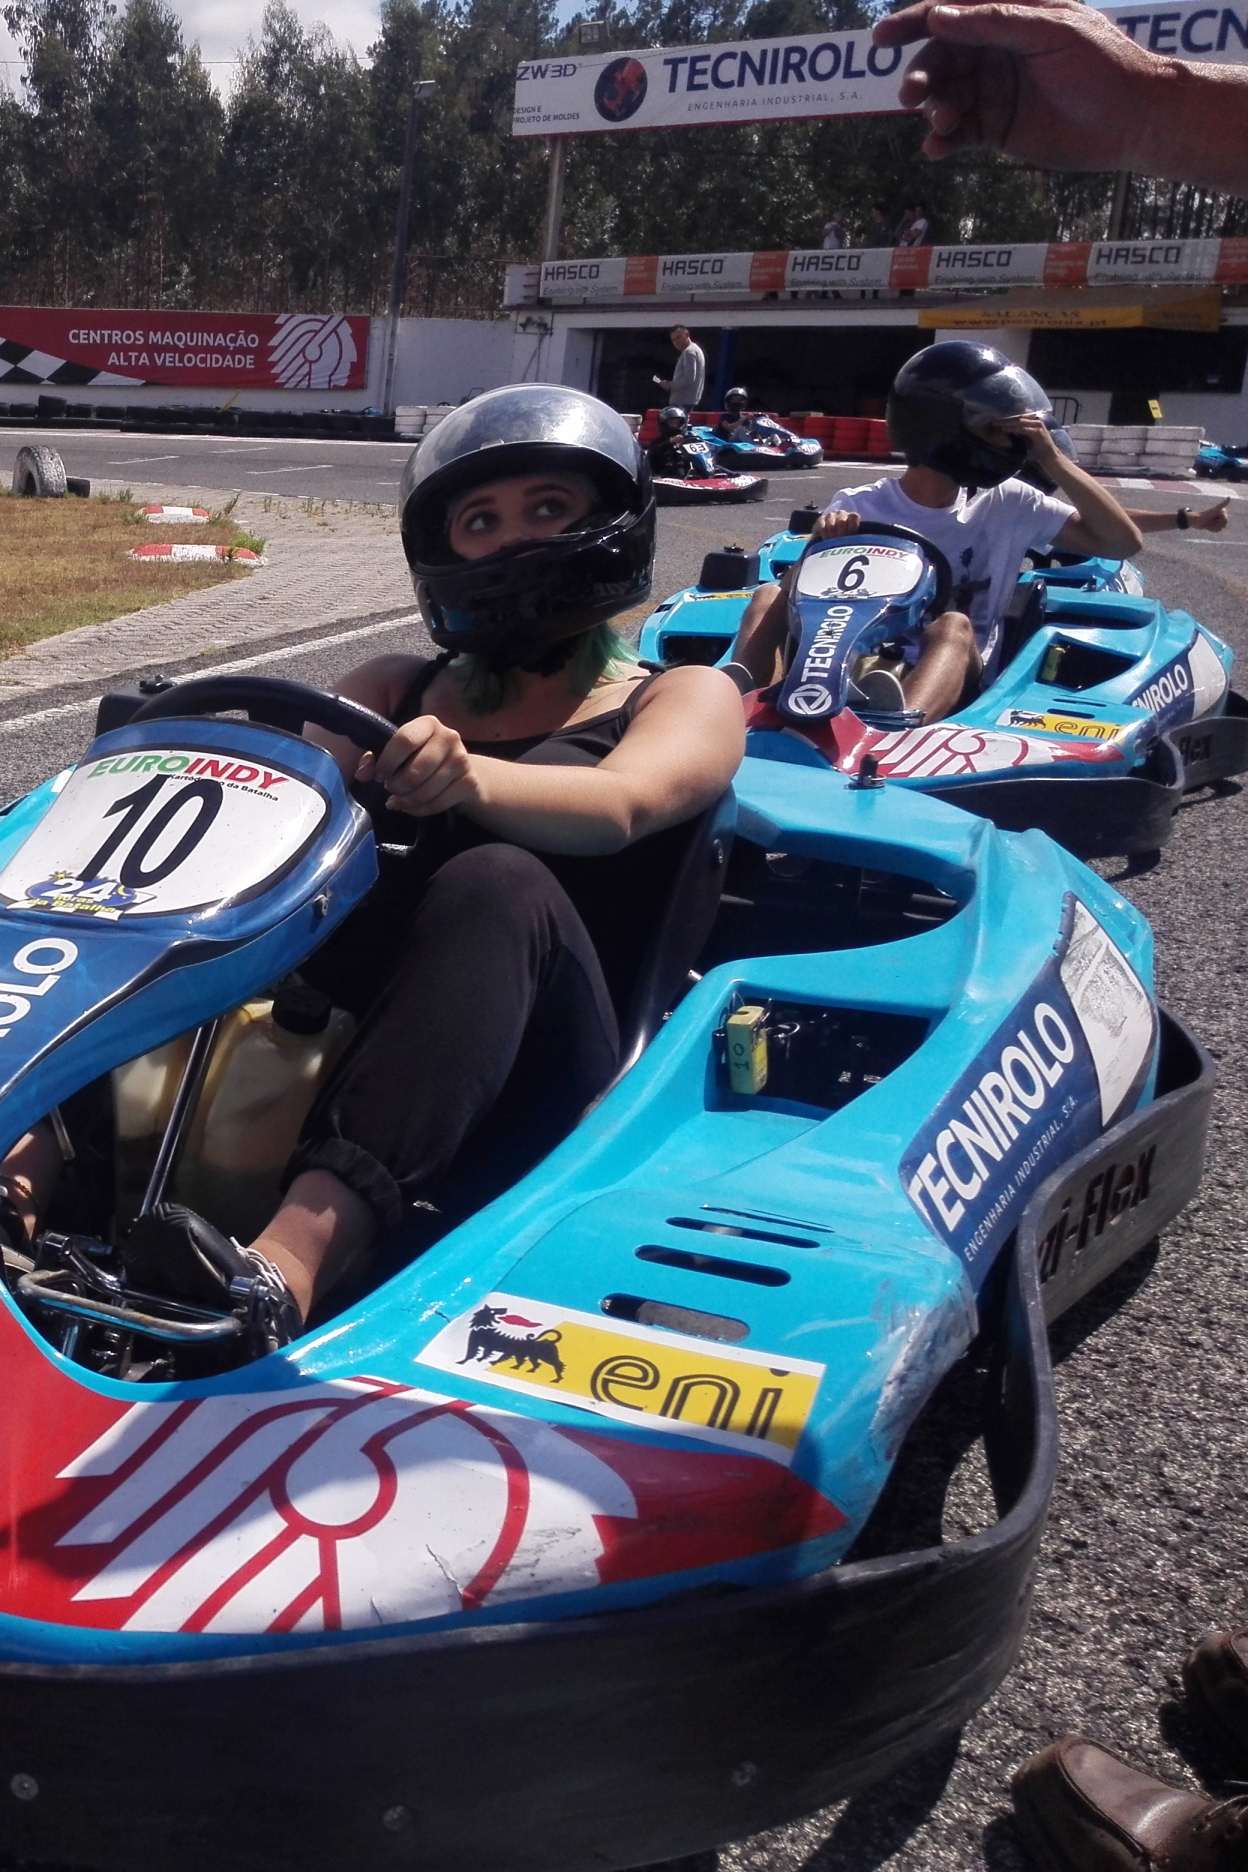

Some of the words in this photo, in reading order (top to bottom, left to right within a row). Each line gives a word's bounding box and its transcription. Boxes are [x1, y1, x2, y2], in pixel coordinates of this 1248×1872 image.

[516, 63, 577, 80] ZW3D
[663, 41, 902, 93] TECNIROLO
[687, 99, 758, 112] ENGENHARIA
[791, 254, 861, 272] HASCO
[936, 250, 1012, 268] HASCO
[1095, 246, 1181, 265] HASCO
[544, 264, 600, 281] HASCO
[662, 259, 724, 276] HASCO
[68, 329, 144, 345] CENTROS
[148, 329, 259, 350] MAQUINAÇÃO
[108, 351, 150, 367] ALTA
[154, 352, 255, 369] VELOCIDADE
[821, 547, 909, 559] EUROINDY
[837, 555, 870, 592] 6
[801, 605, 854, 683] TECNIROLO
[1055, 721, 1121, 741] eni
[88, 755, 288, 789] EUROINDY
[227, 782, 239, 790] da
[241, 785, 279, 802] Batalha
[79, 773, 224, 889] 10
[40, 879, 118, 902] 24
[908, 1002, 1075, 1233] TECNIROLO
[963, 1184, 1017, 1263] ENGENHARIA
[590, 1355, 790, 1440] eni
